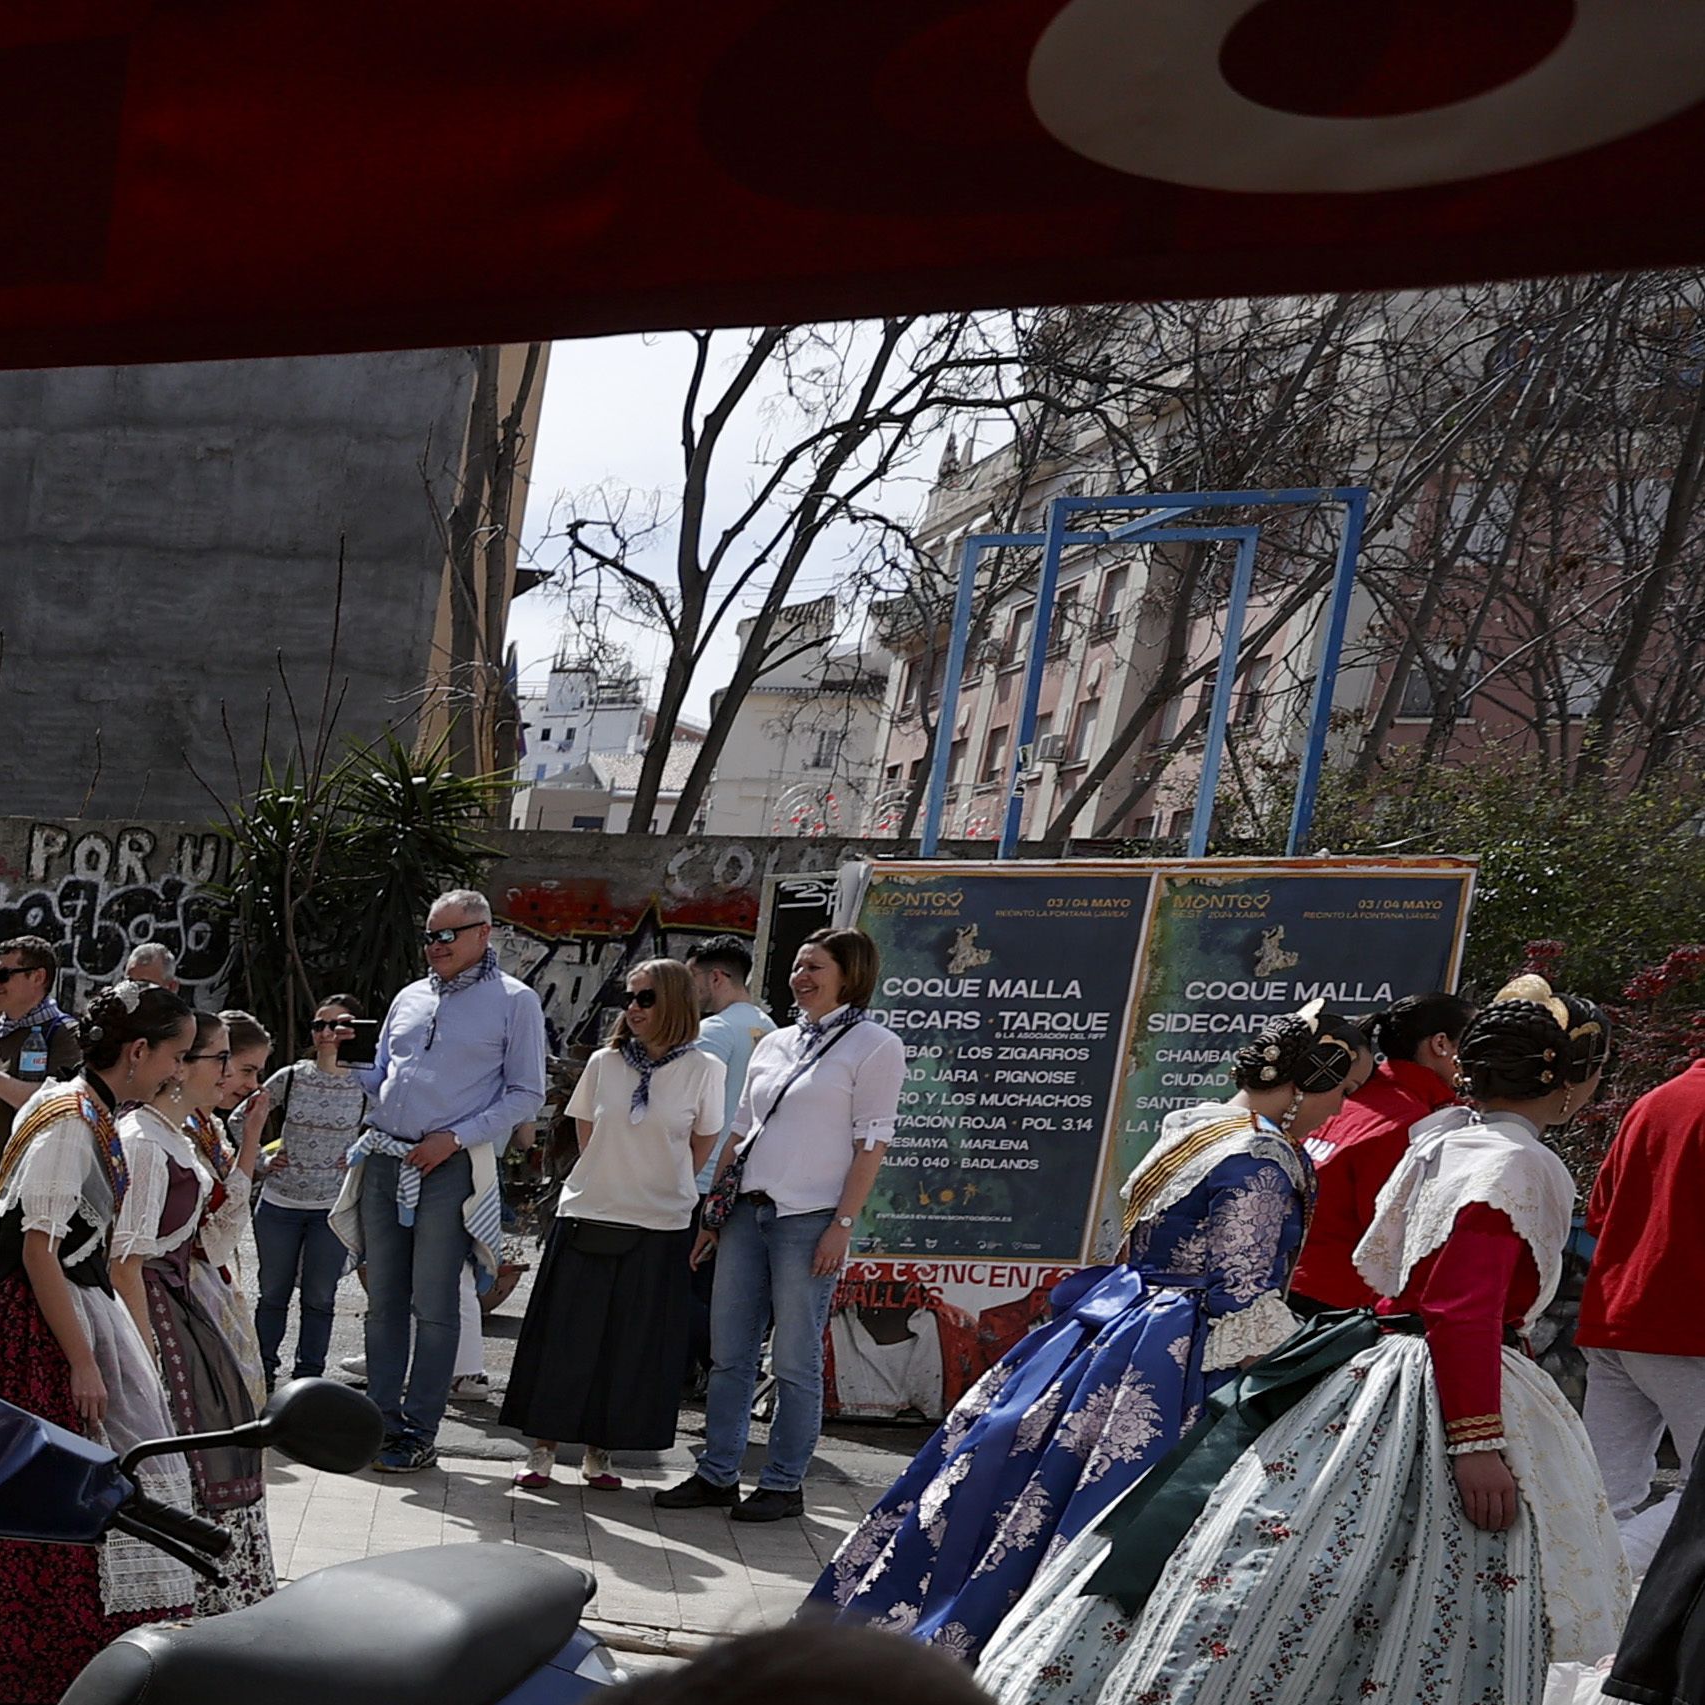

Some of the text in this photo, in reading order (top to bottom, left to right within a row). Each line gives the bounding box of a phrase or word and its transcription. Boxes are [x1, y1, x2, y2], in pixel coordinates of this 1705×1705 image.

[27, 823, 157, 890] POR
[1091, 898, 1132, 908] MAYO
[1171, 891, 1272, 909] MONTGÓ
[1402, 899, 1443, 910] MAYO
[882, 977, 1083, 1000] COQUE MALLA
[1184, 980, 1392, 1003] COQUE MALLA
[872, 1009, 1111, 1032] DECARS TARQUE
[957, 1046, 994, 1060] LOS
[996, 1047, 1091, 1061] ZIGARROS
[931, 1069, 979, 1082] JARA
[994, 1070, 1078, 1084] PIGNOISE
[1161, 1073, 1230, 1087] CIUDAD
[924, 1092, 938, 1105] Y
[941, 1093, 976, 1106] LOS
[979, 1094, 1093, 1108] MUCHACHOS
[958, 1116, 1007, 1130] ROJA
[1021, 1117, 1057, 1130] POL
[1061, 1118, 1094, 1132] 3.14
[1125, 1119, 1151, 1133] LA
[887, 1136, 1029, 1150] ESMAYA MARLENA
[921, 1157, 950, 1169] 040
[960, 1158, 1040, 1170] BADLANDS
